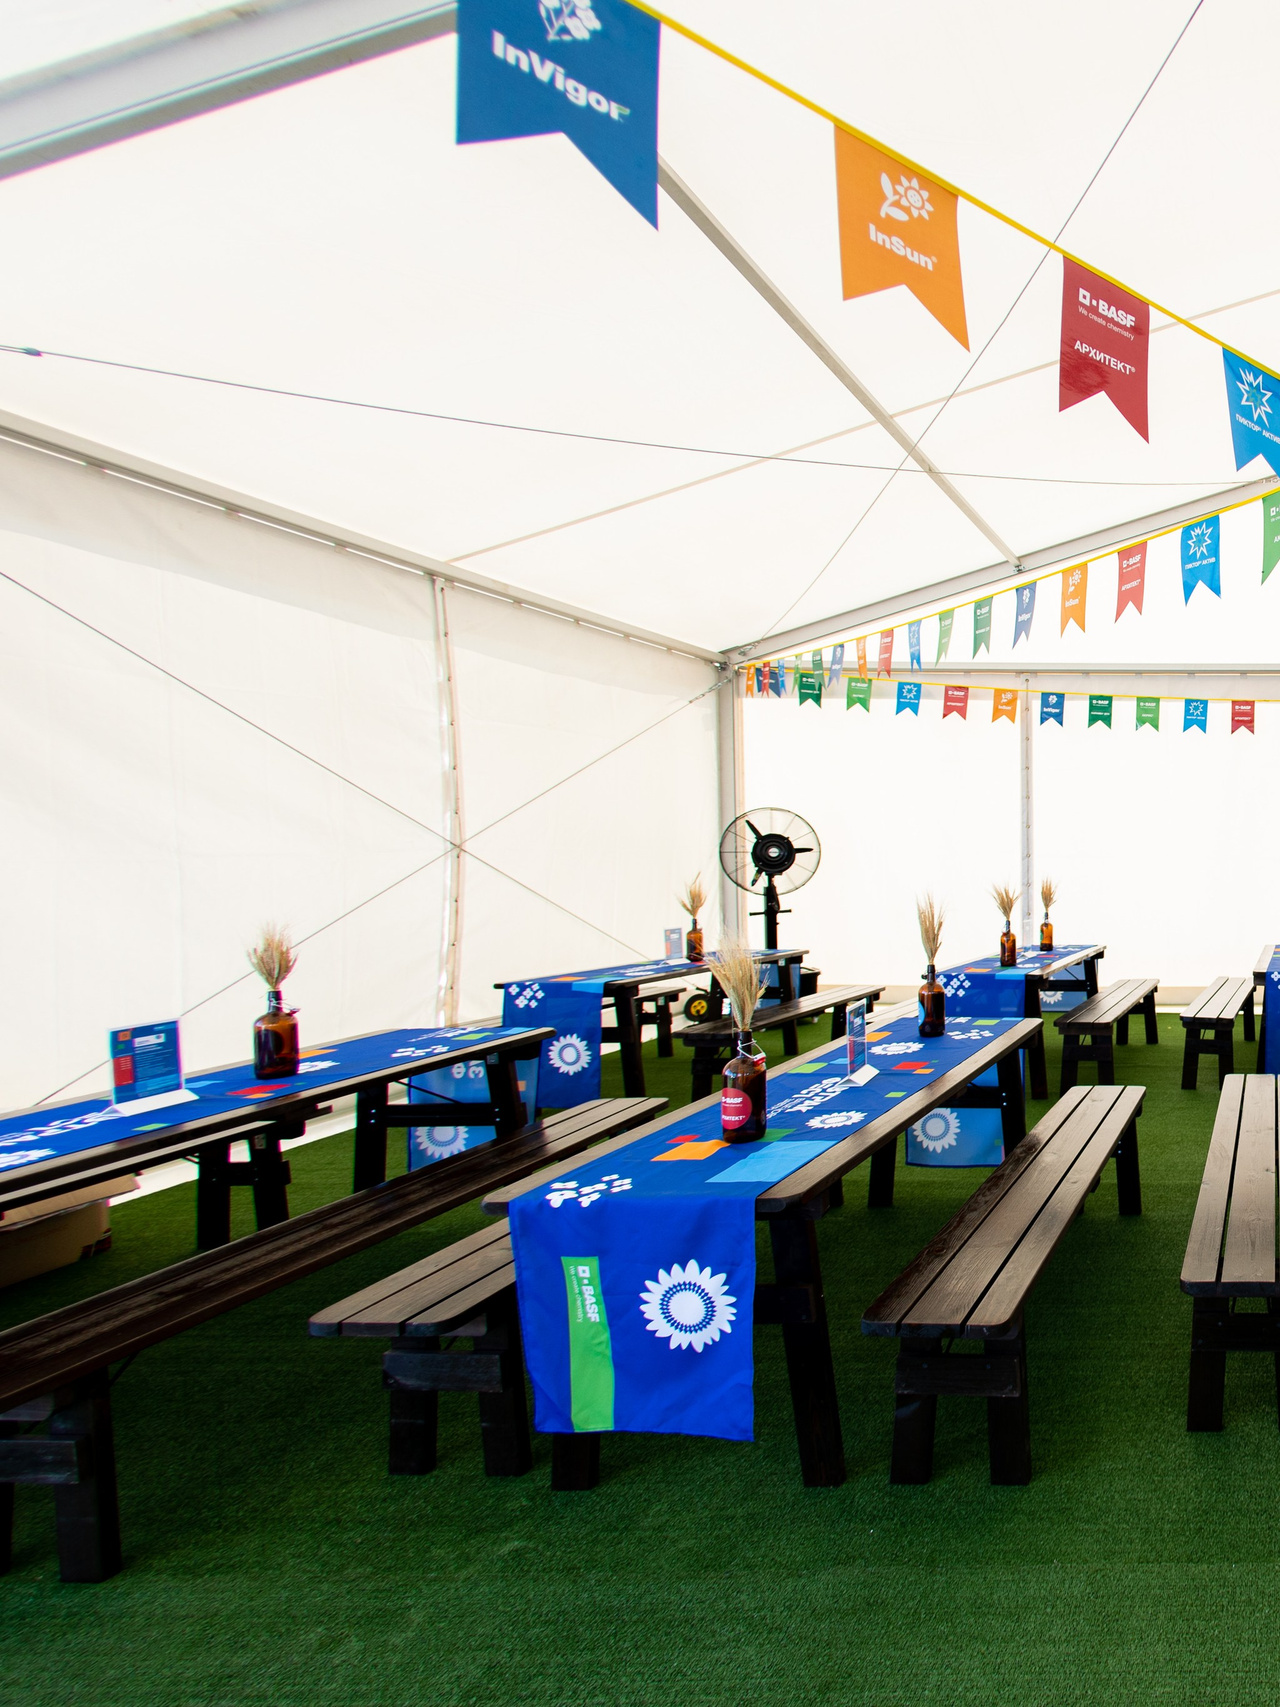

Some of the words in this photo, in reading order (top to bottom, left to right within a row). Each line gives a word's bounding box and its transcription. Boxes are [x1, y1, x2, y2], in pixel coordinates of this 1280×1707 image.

[492, 30, 631, 122] InVigor
[1078, 305, 1087, 314] We
[1088, 310, 1106, 326] create
[1107, 319, 1135, 341] chemistry
[1097, 298, 1136, 328] BASF
[582, 1285, 600, 1323] BASF
